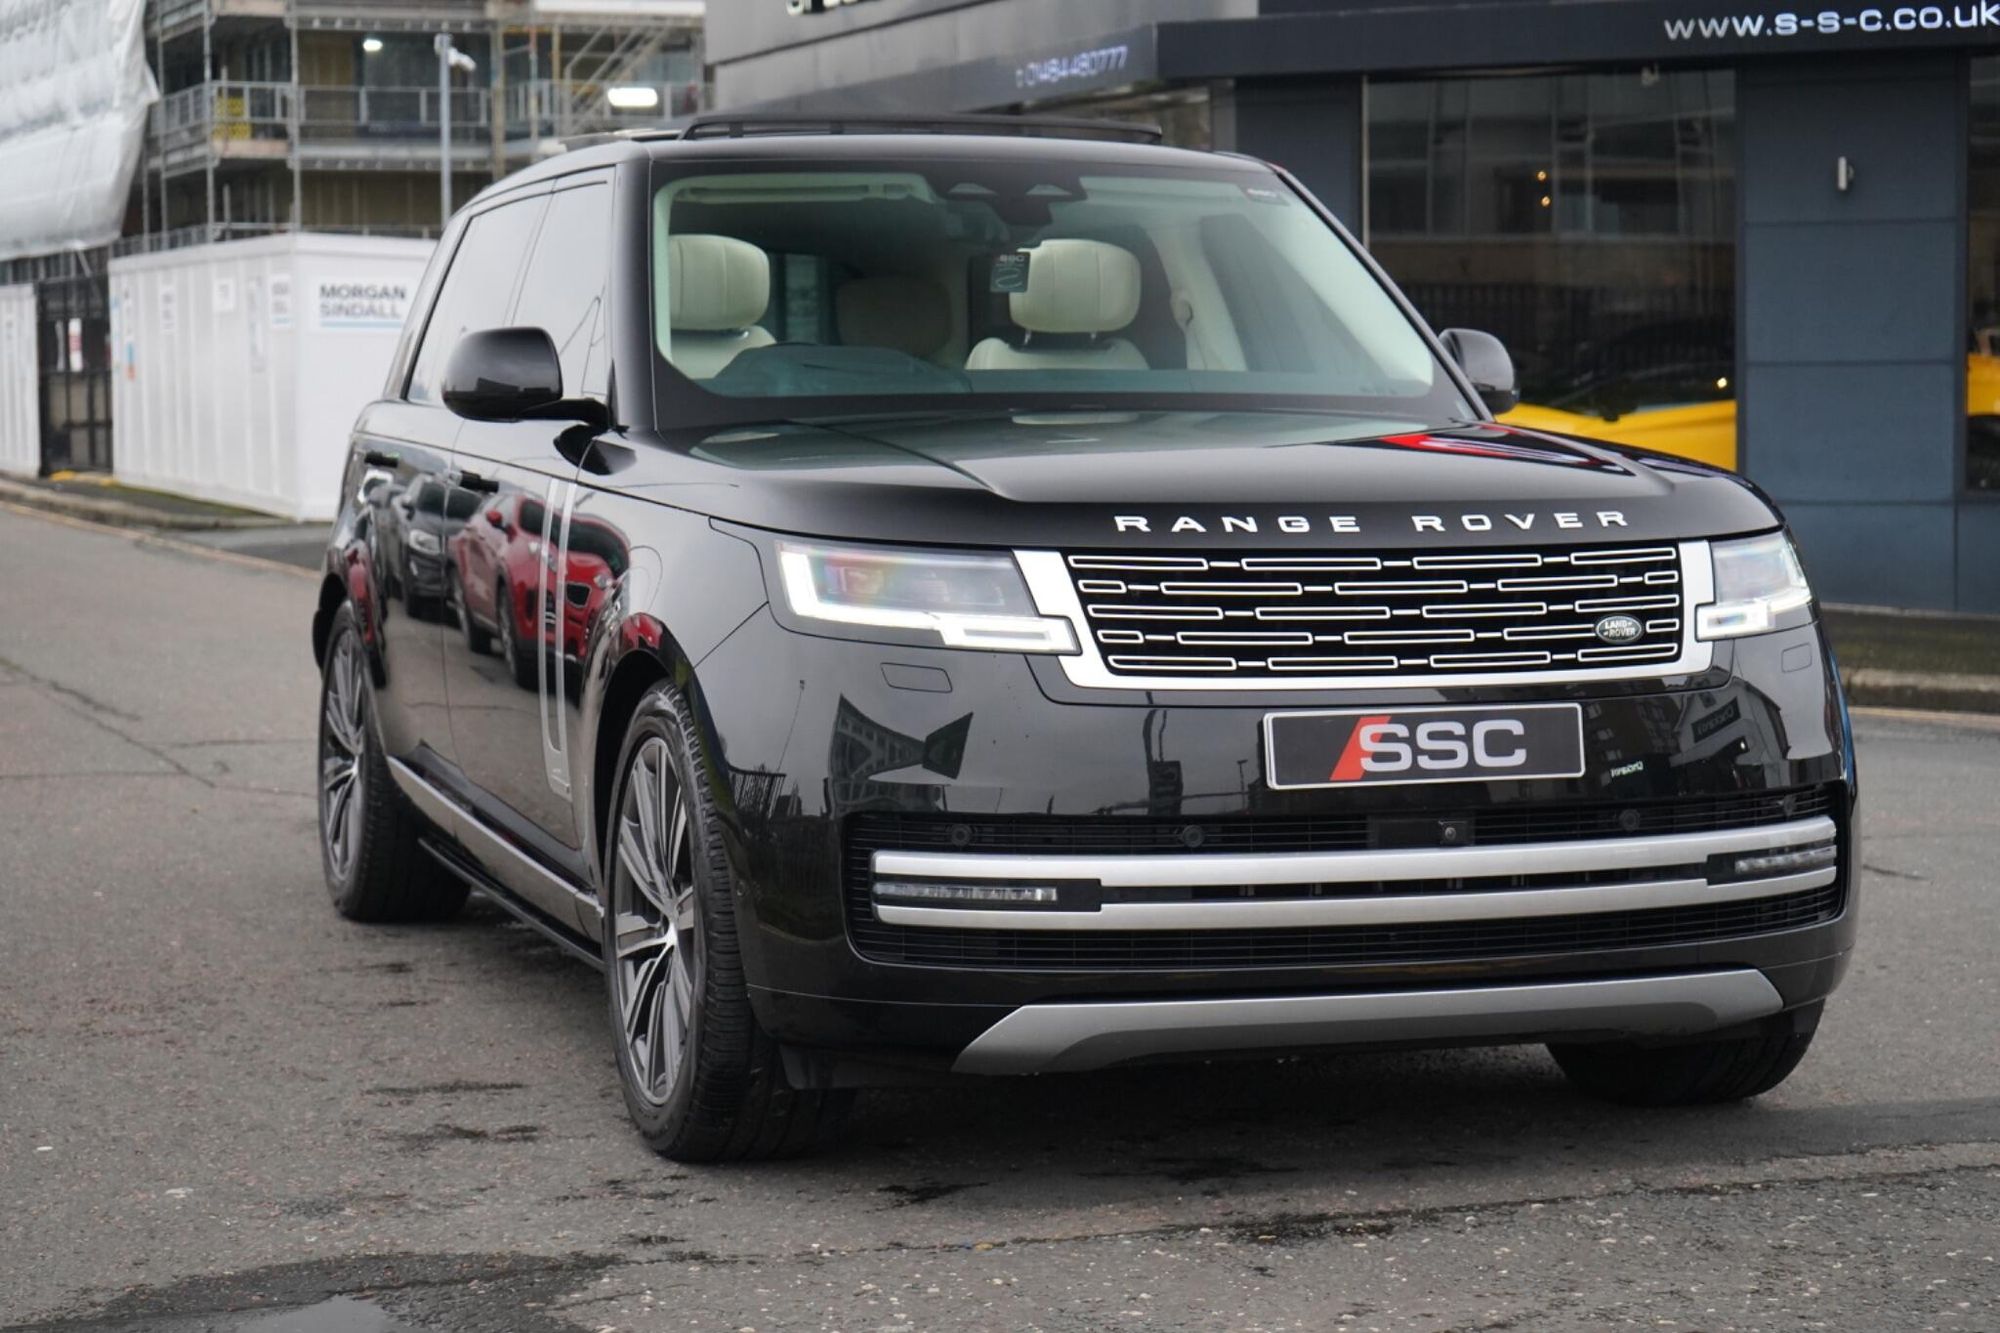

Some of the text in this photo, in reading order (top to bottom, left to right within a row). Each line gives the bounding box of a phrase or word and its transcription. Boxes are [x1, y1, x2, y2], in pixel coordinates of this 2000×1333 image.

[1664, 0, 2000, 40] www.s-s-c.co.uk
[320, 284, 406, 299] MORGAN
[320, 302, 402, 319] SINDALL
[1114, 511, 1629, 533] RANGE ROVER
[1604, 619, 1628, 630] LAND
[1608, 627, 1636, 638] ROVER
[1358, 719, 1527, 772] SSC
